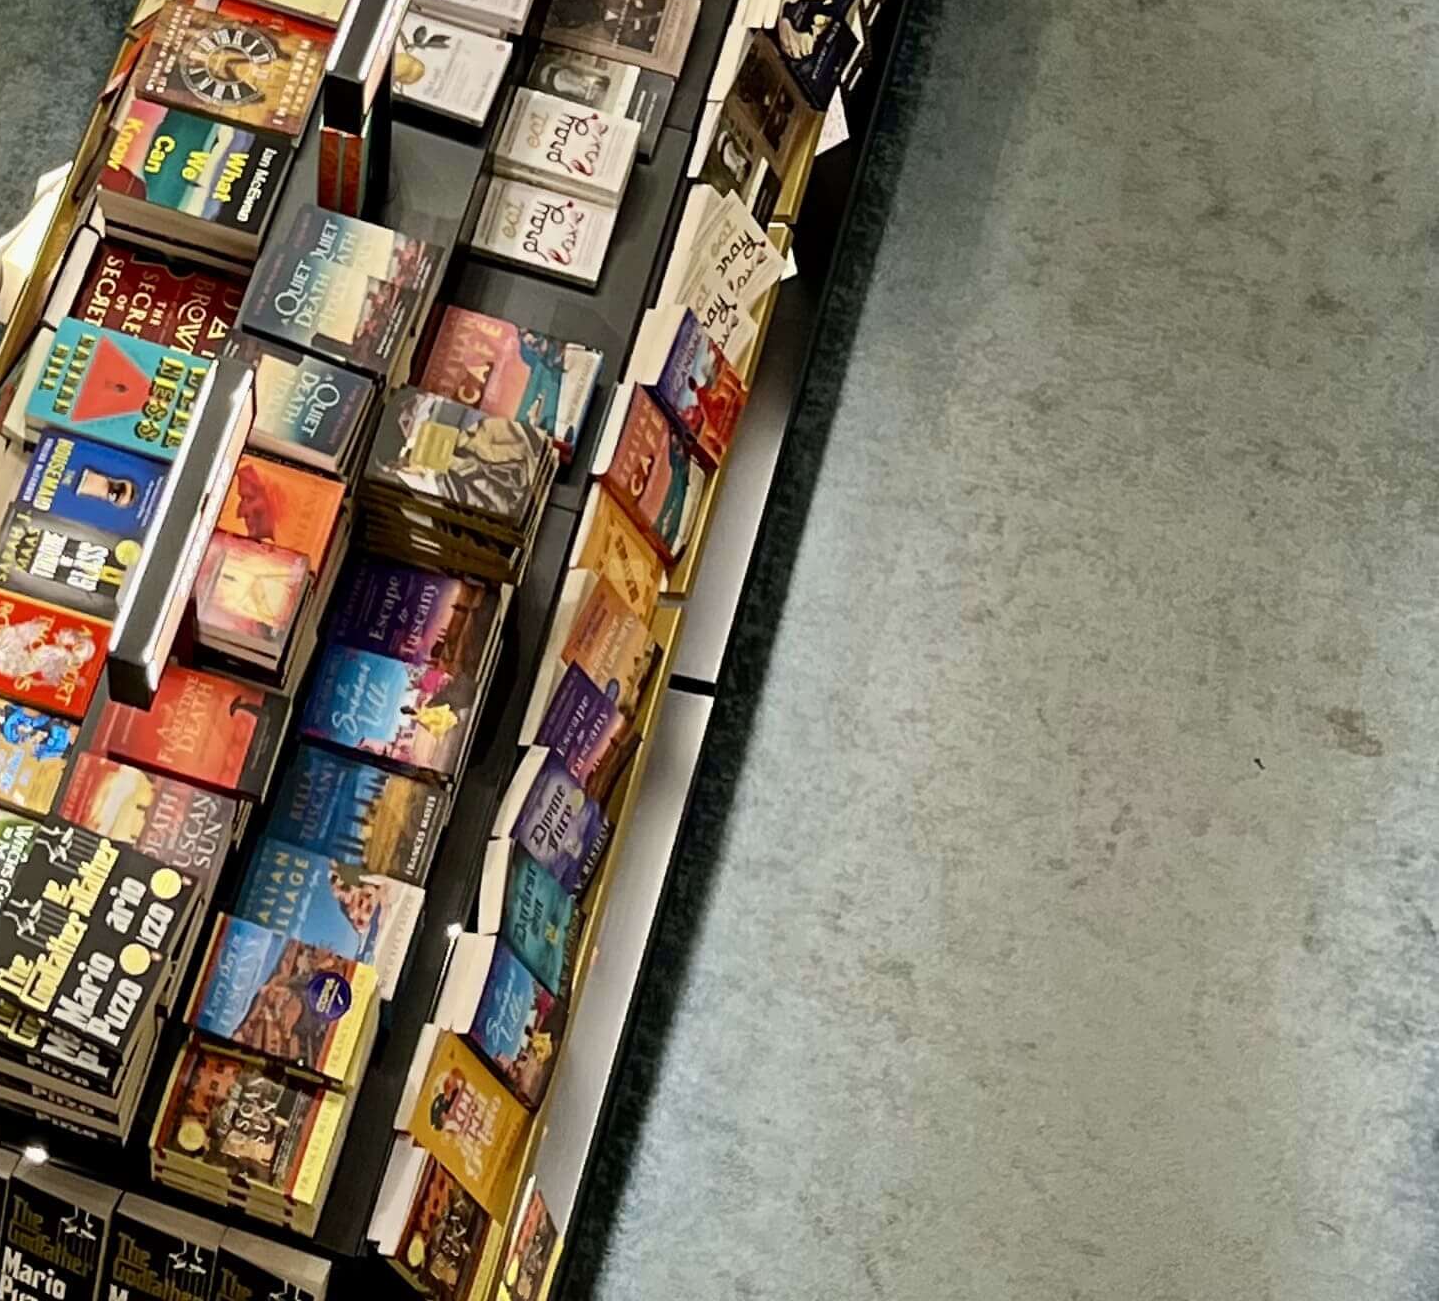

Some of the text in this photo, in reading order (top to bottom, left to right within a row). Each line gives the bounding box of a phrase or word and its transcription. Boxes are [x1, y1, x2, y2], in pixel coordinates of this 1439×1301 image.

[271, 38, 311, 127] MURAKAMI
[105, 114, 143, 171] Know
[144, 133, 175, 175] Can
[180, 148, 208, 182] We
[259, 147, 275, 167] Ian
[540, 102, 597, 173] pray
[212, 148, 248, 204] What
[235, 167, 268, 224] McEwan
[512, 188, 571, 261] pray
[84, 254, 124, 326] SECRET
[113, 293, 126, 310] OF
[116, 267, 158, 337] SECRE
[150, 300, 167, 326] THE
[168, 276, 214, 354] BROW
[294, 269, 330, 328] DEATH
[38, 341, 70, 394] HILL
[283, 370, 319, 427] DEATH
[298, 379, 342, 441] QUIET
[31, 436, 74, 513] HOUSEMAID
[368, 574, 407, 641] Escape
[400, 578, 440, 657] Tuscany
[157, 673, 201, 765] FLORENTINE
[174, 680, 214, 753] DEATH
[171, 792, 213, 869] USCAN
[191, 818, 224, 869] SUN
[93, 870, 151, 935] ario
[14, 907, 96, 1014] Godfather
[51, 945, 120, 1029] Mario
[84, 971, 149, 1048] Puzo
[13, 1195, 45, 1228] The
[4, 1245, 68, 1300] Mario
[118, 1231, 151, 1267] The
